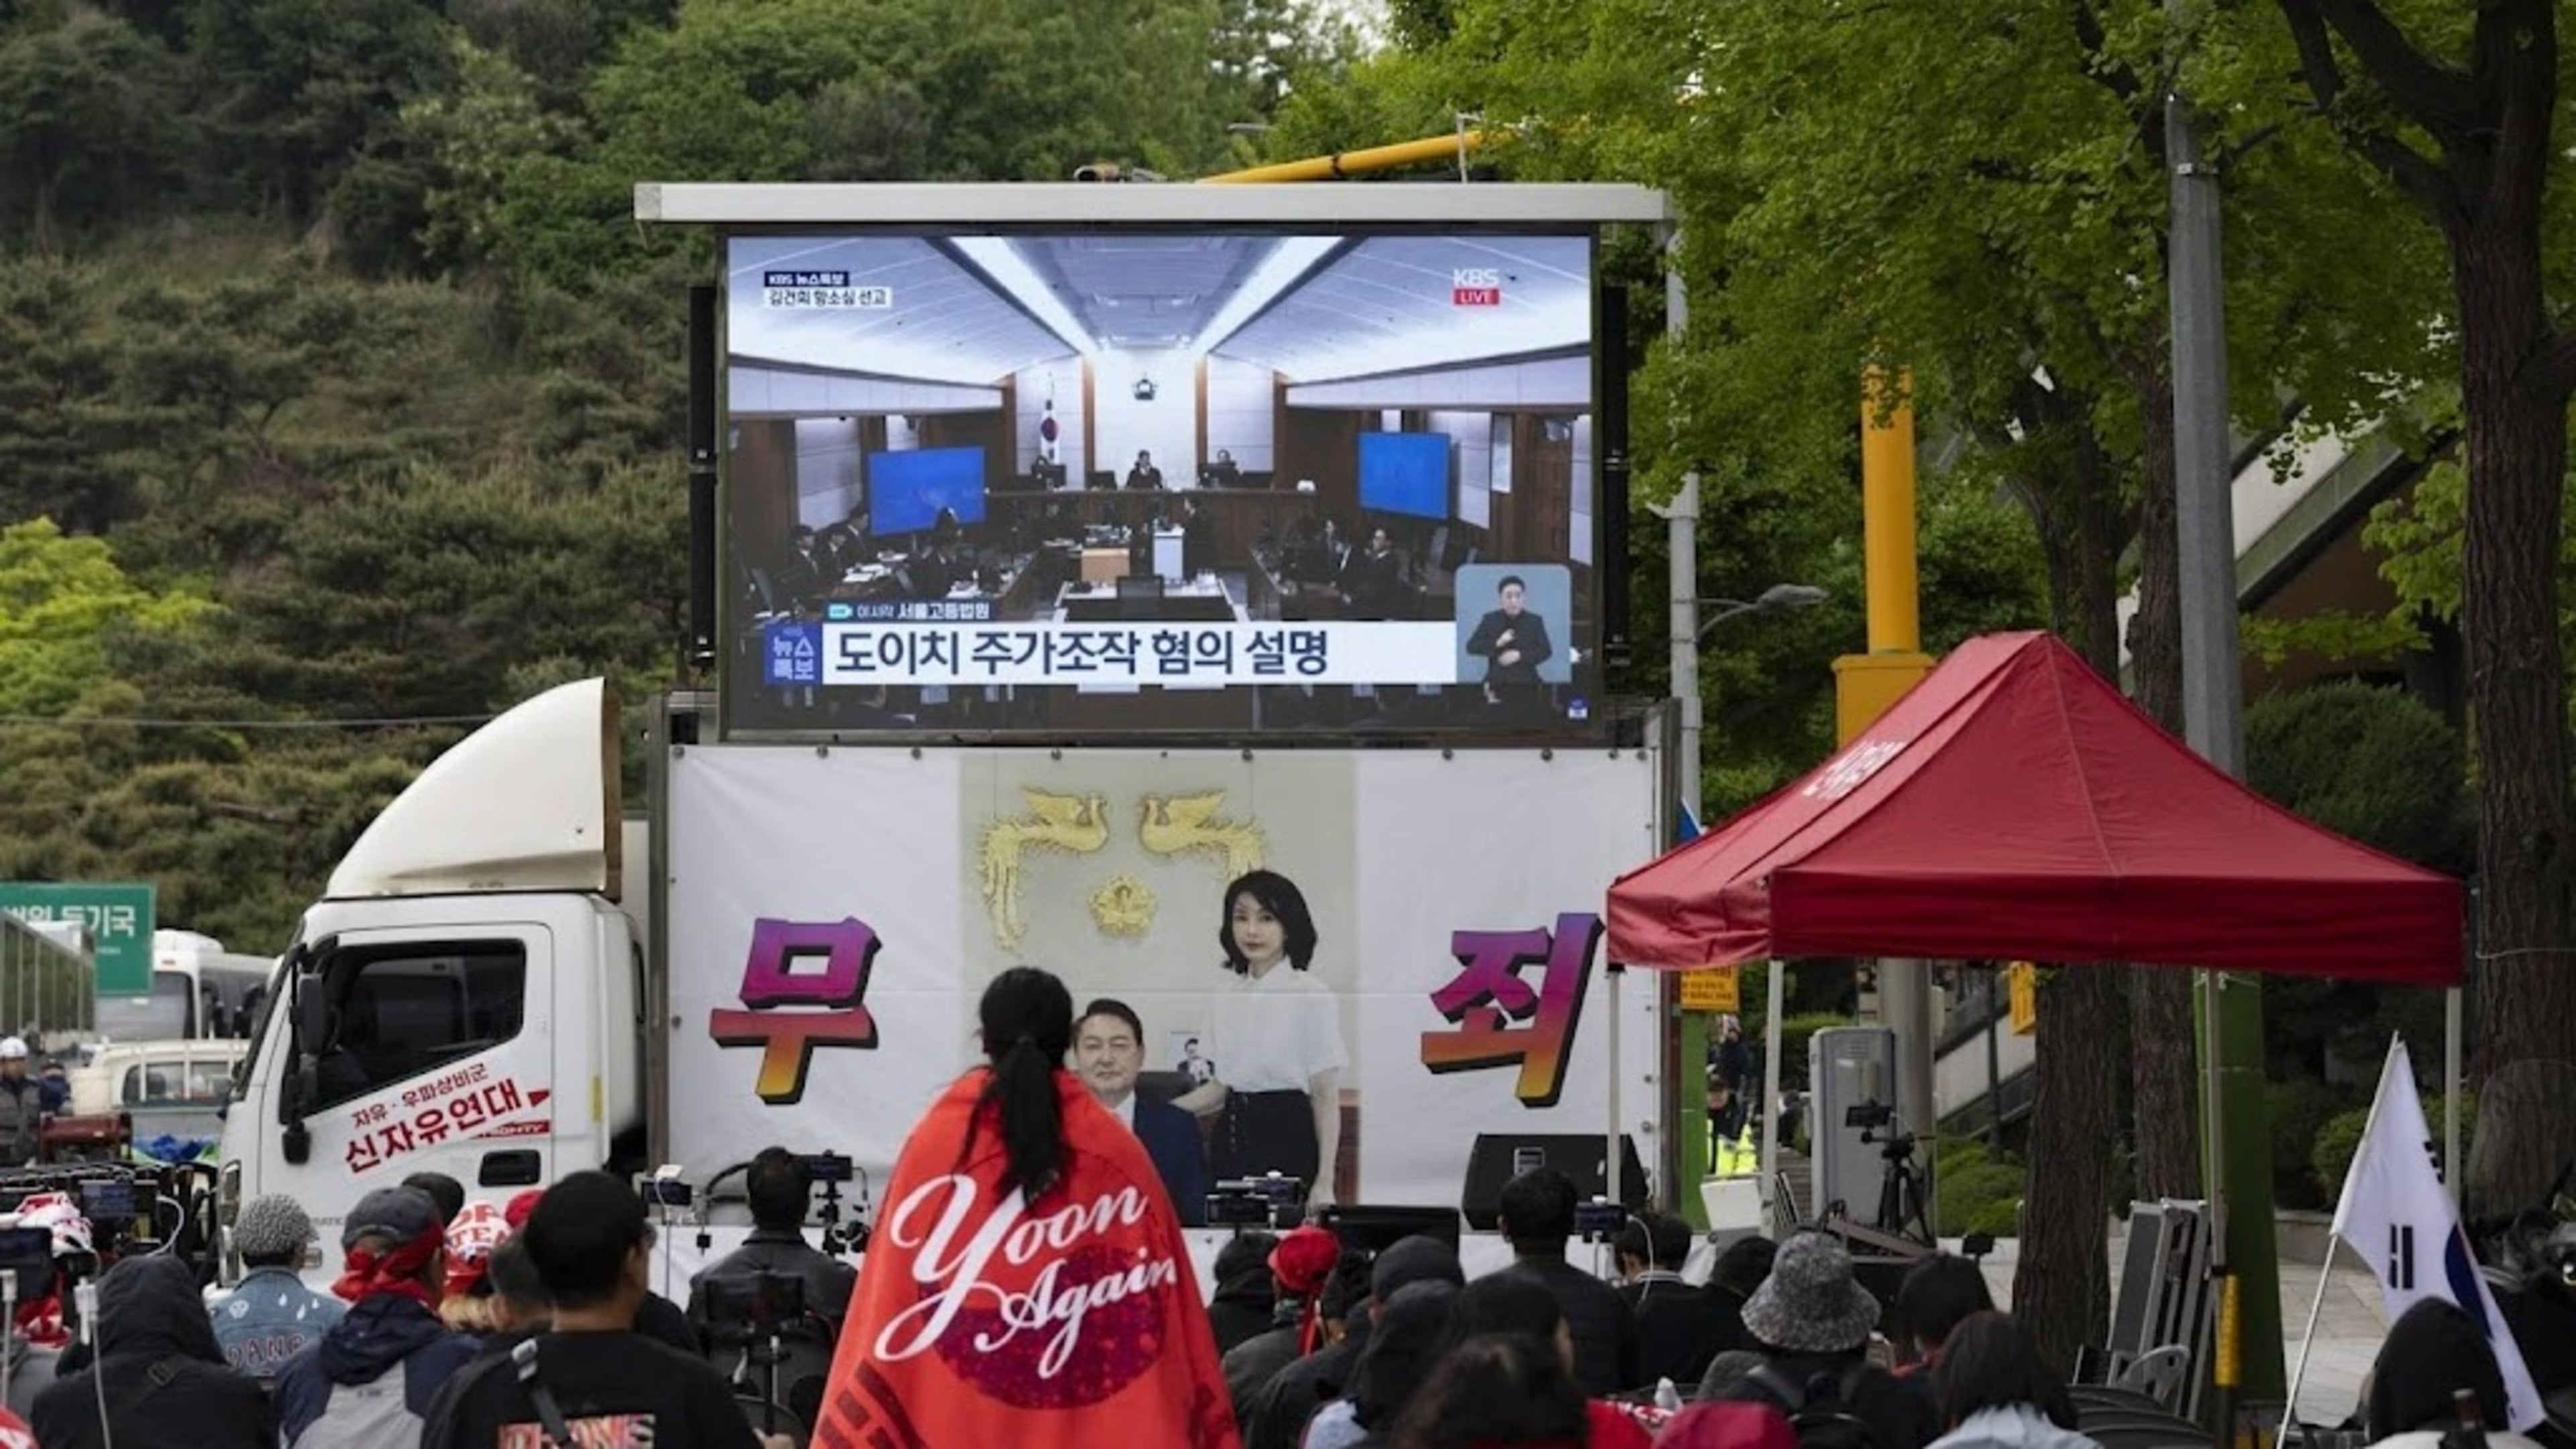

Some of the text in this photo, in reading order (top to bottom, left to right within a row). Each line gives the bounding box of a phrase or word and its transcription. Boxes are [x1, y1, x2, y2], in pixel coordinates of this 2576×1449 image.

[1453, 268, 1499, 286] KBS
[769, 289, 886, 307] 김건희 항소심 선고
[1461, 291, 1489, 304] LIVE
[898, 602, 989, 619] 서울고등법원
[773, 636, 814, 657] 뉴스
[836, 631, 1328, 675] 도이치 주가조작 혐의 설명
[4, 905, 54, 922] 원
[709, 912, 1605, 1110] 무 죄
[350, 1102, 388, 1128] 자유
[402, 1063, 490, 1109] 우파상비군
[345, 1078, 522, 1174] 신자유연대
[874, 1174, 1149, 1362] Yoon
[970, 1246, 1178, 1380] Again
